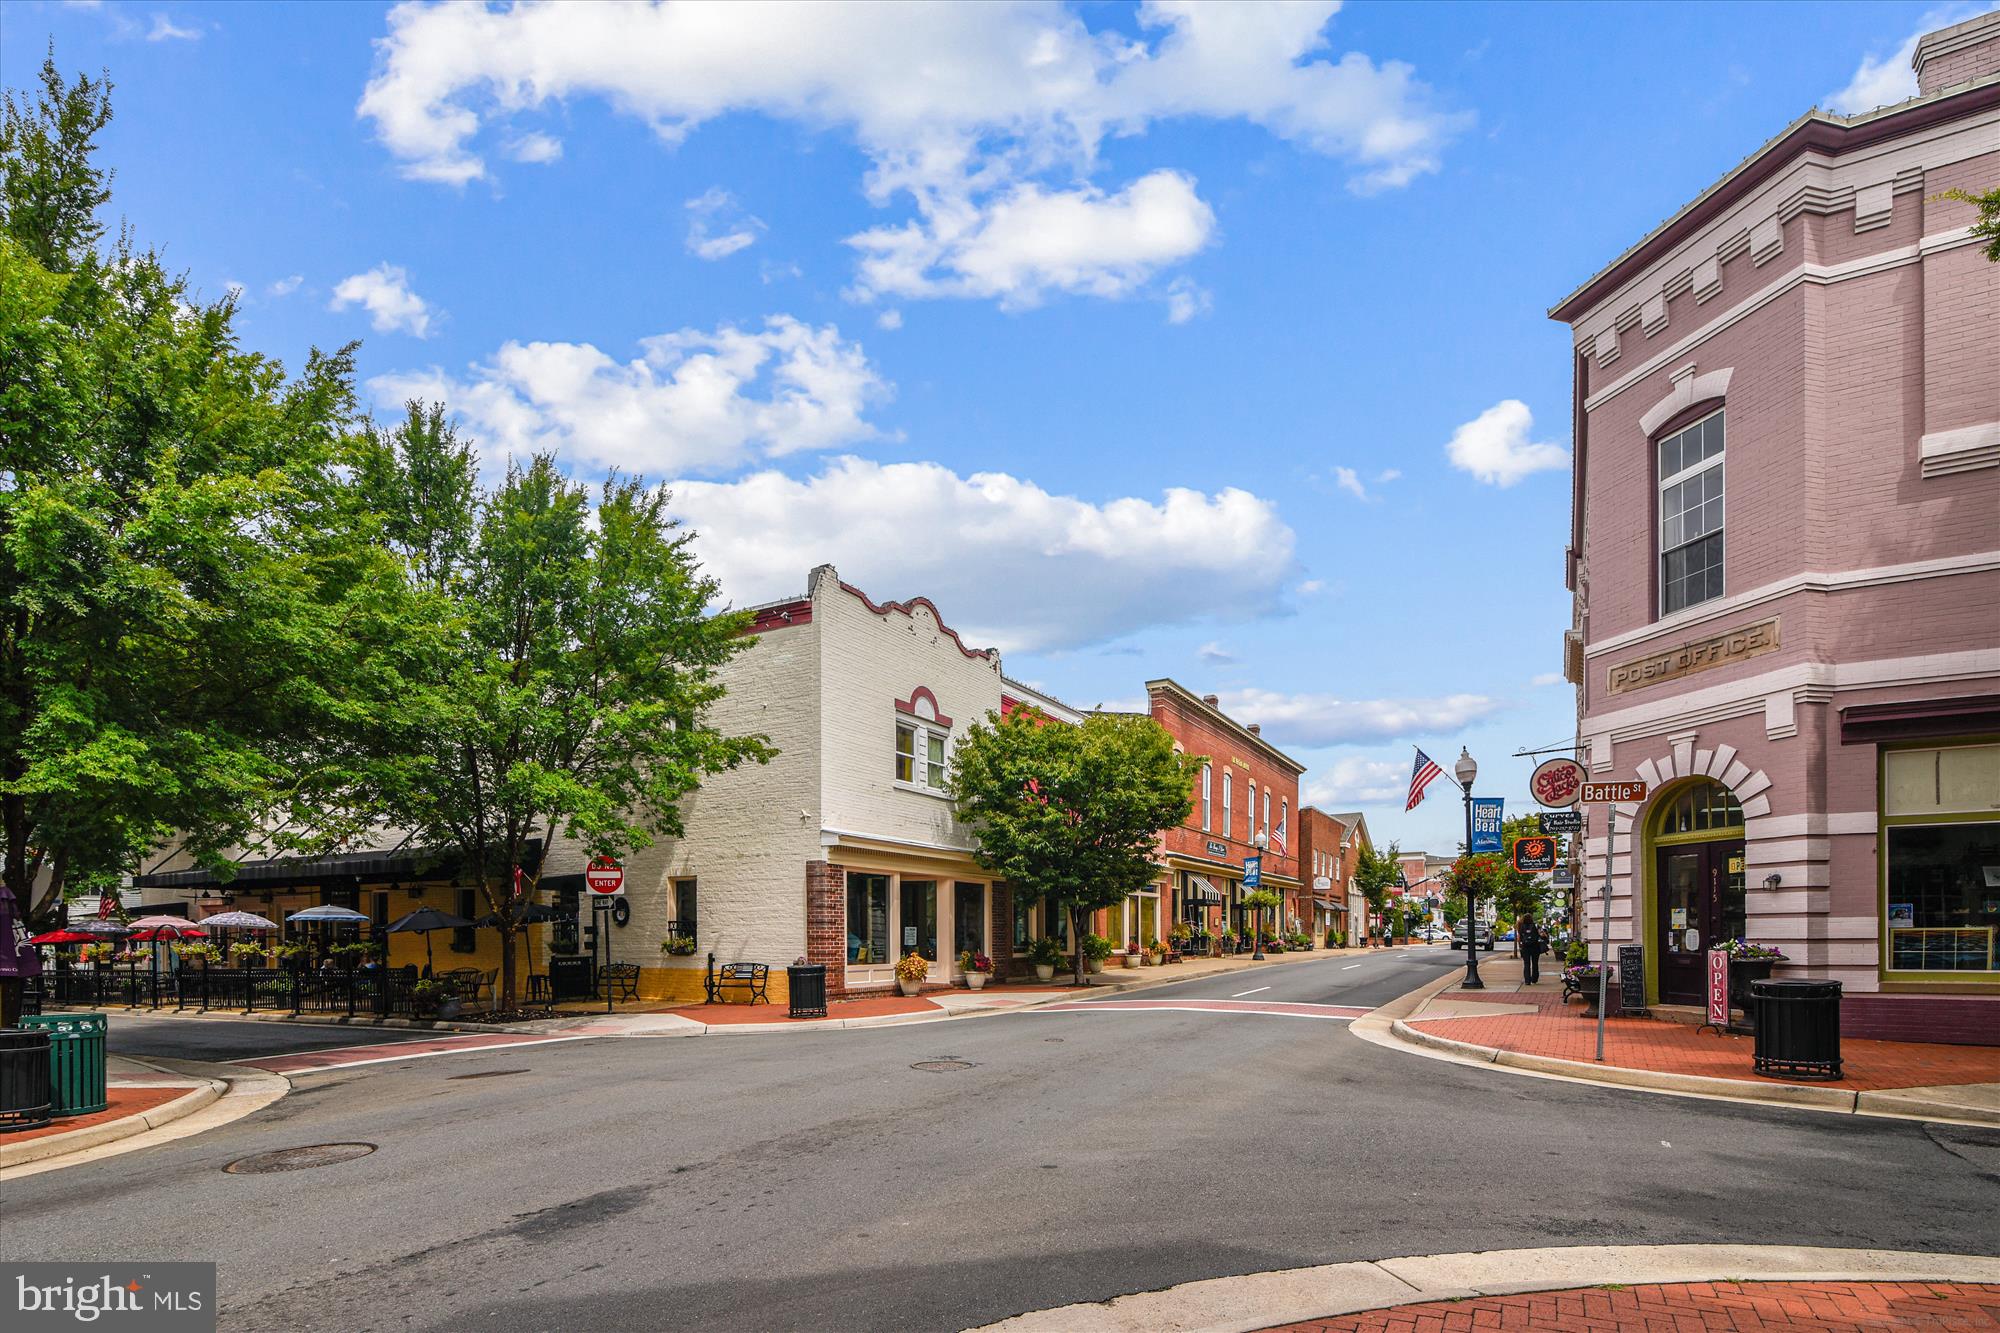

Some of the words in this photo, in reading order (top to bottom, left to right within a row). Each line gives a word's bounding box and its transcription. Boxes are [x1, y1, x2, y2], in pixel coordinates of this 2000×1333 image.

[1615, 656, 1671, 687] POST
[1537, 765, 1577, 791] Calico
[1545, 776, 1580, 803] Jack's
[1584, 784, 1631, 800] Battle
[1632, 784, 1641, 792] St
[1475, 804, 1501, 819] Heart
[1475, 818, 1500, 832] Beat
[1712, 956, 1723, 1017] OPEN
